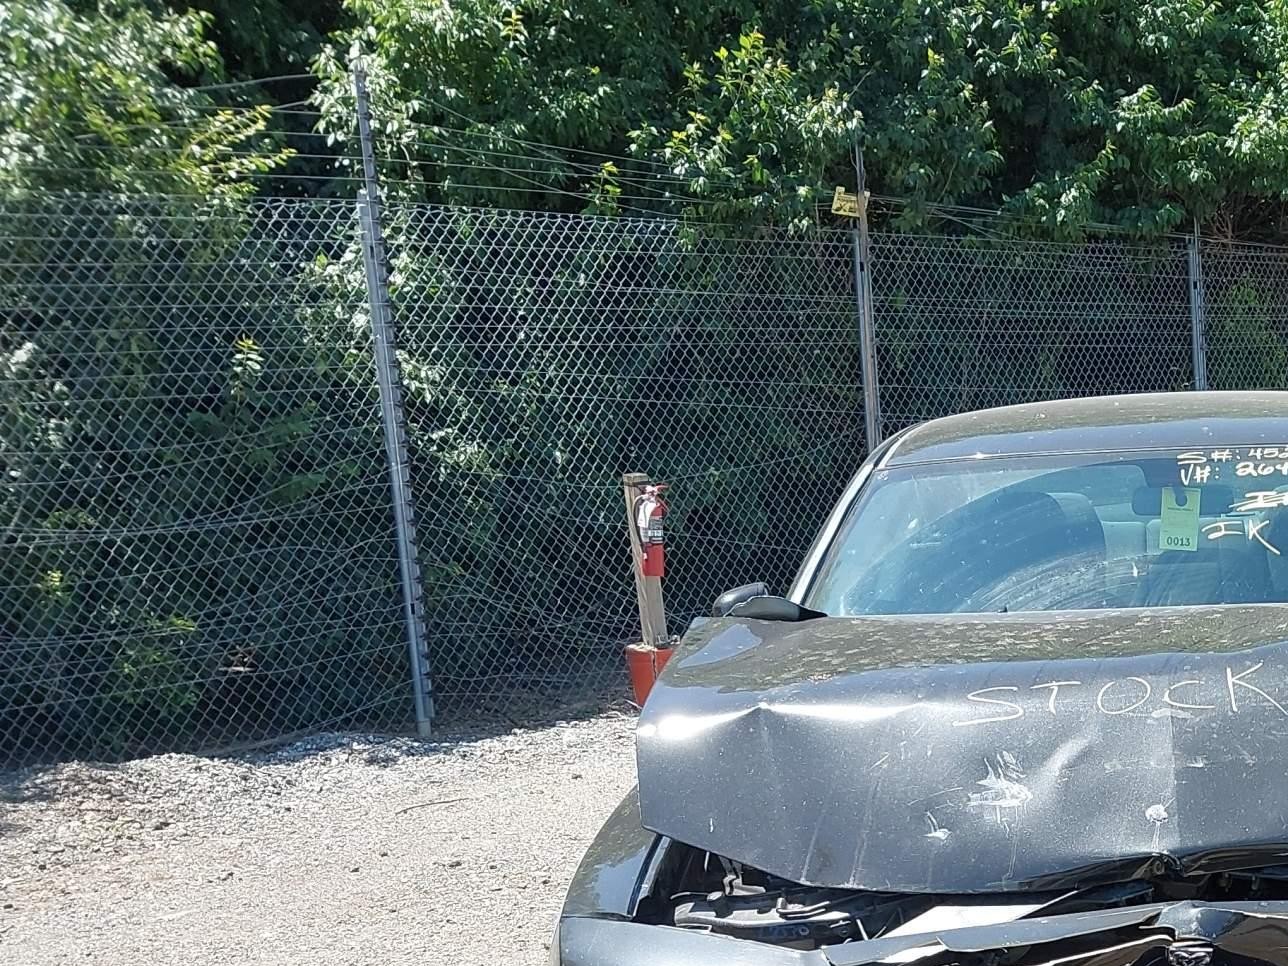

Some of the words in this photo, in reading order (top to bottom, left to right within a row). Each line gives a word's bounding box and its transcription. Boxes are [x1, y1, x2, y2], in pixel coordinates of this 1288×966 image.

[1180, 463, 1220, 486] V#:
[1166, 536, 1191, 547] 0013
[952, 659, 1288, 727] STOCK
